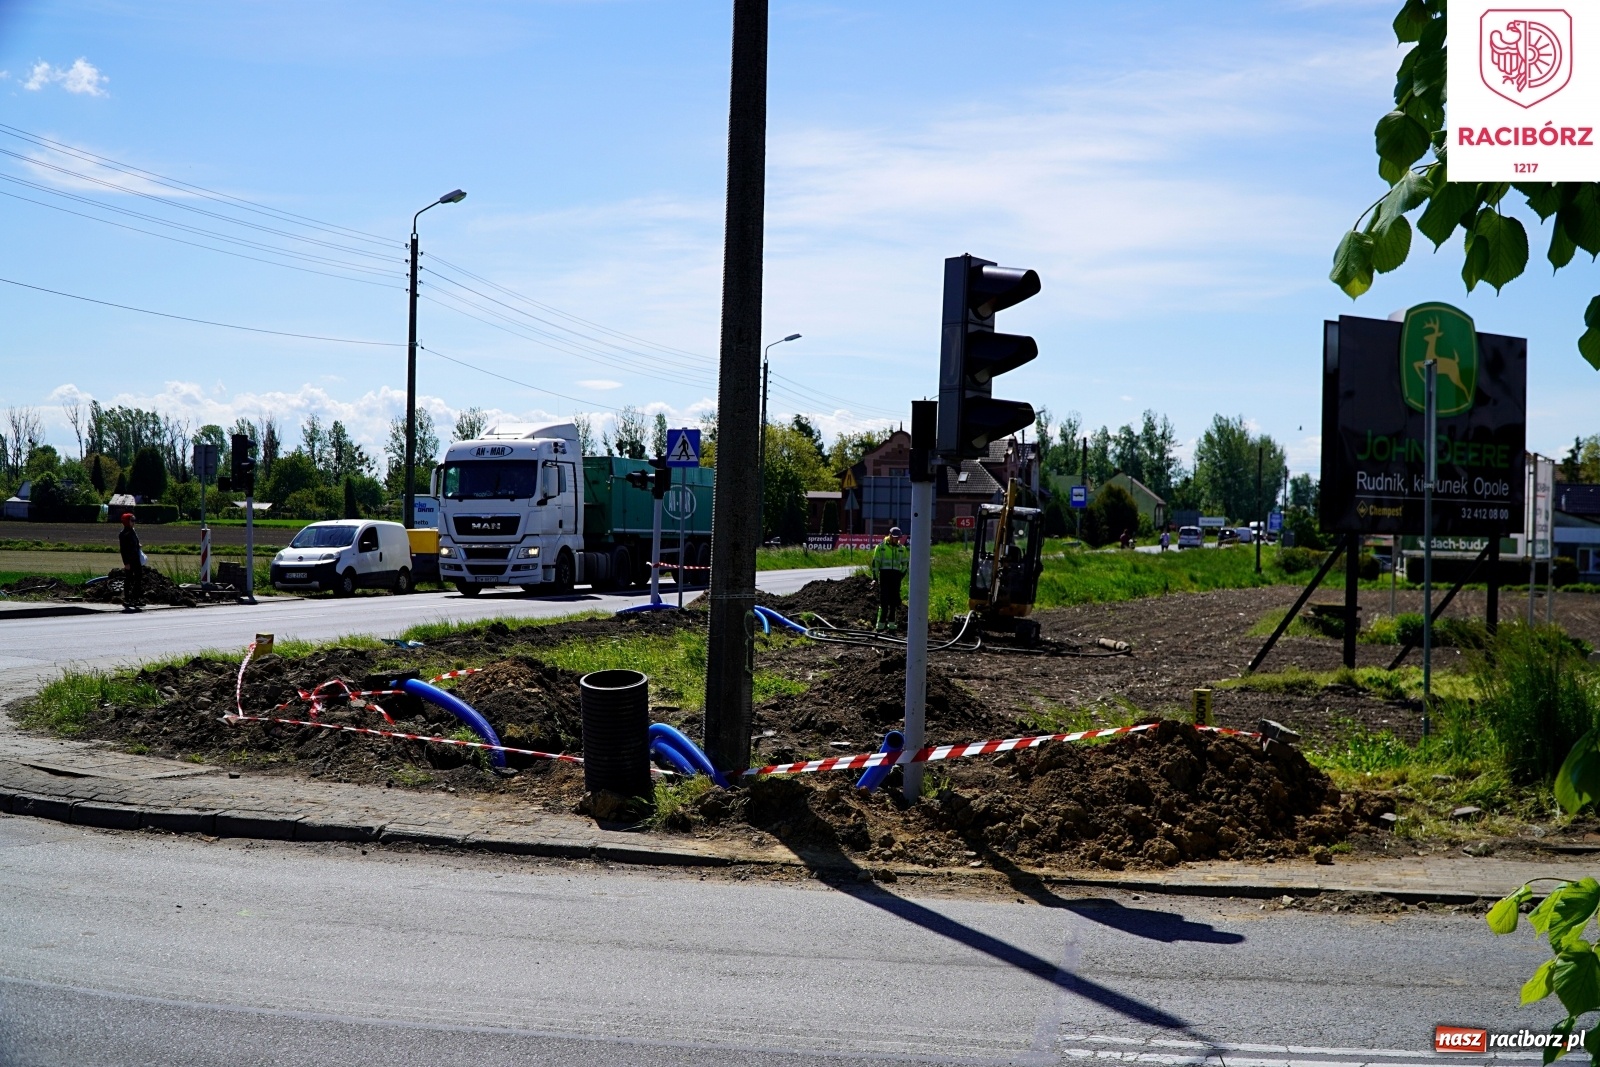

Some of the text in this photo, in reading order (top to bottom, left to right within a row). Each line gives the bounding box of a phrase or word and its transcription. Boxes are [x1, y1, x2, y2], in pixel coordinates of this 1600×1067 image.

[1356, 471, 1409, 495] Rudnik,
[1473, 477, 1509, 499] Opole
[1369, 505, 1402, 518] Chempest
[1461, 507, 1509, 520] 32 412 08 00
[471, 522, 501, 530] MAN
[960, 518, 971, 527] 45
[807, 535, 833, 543] sprzedaż
